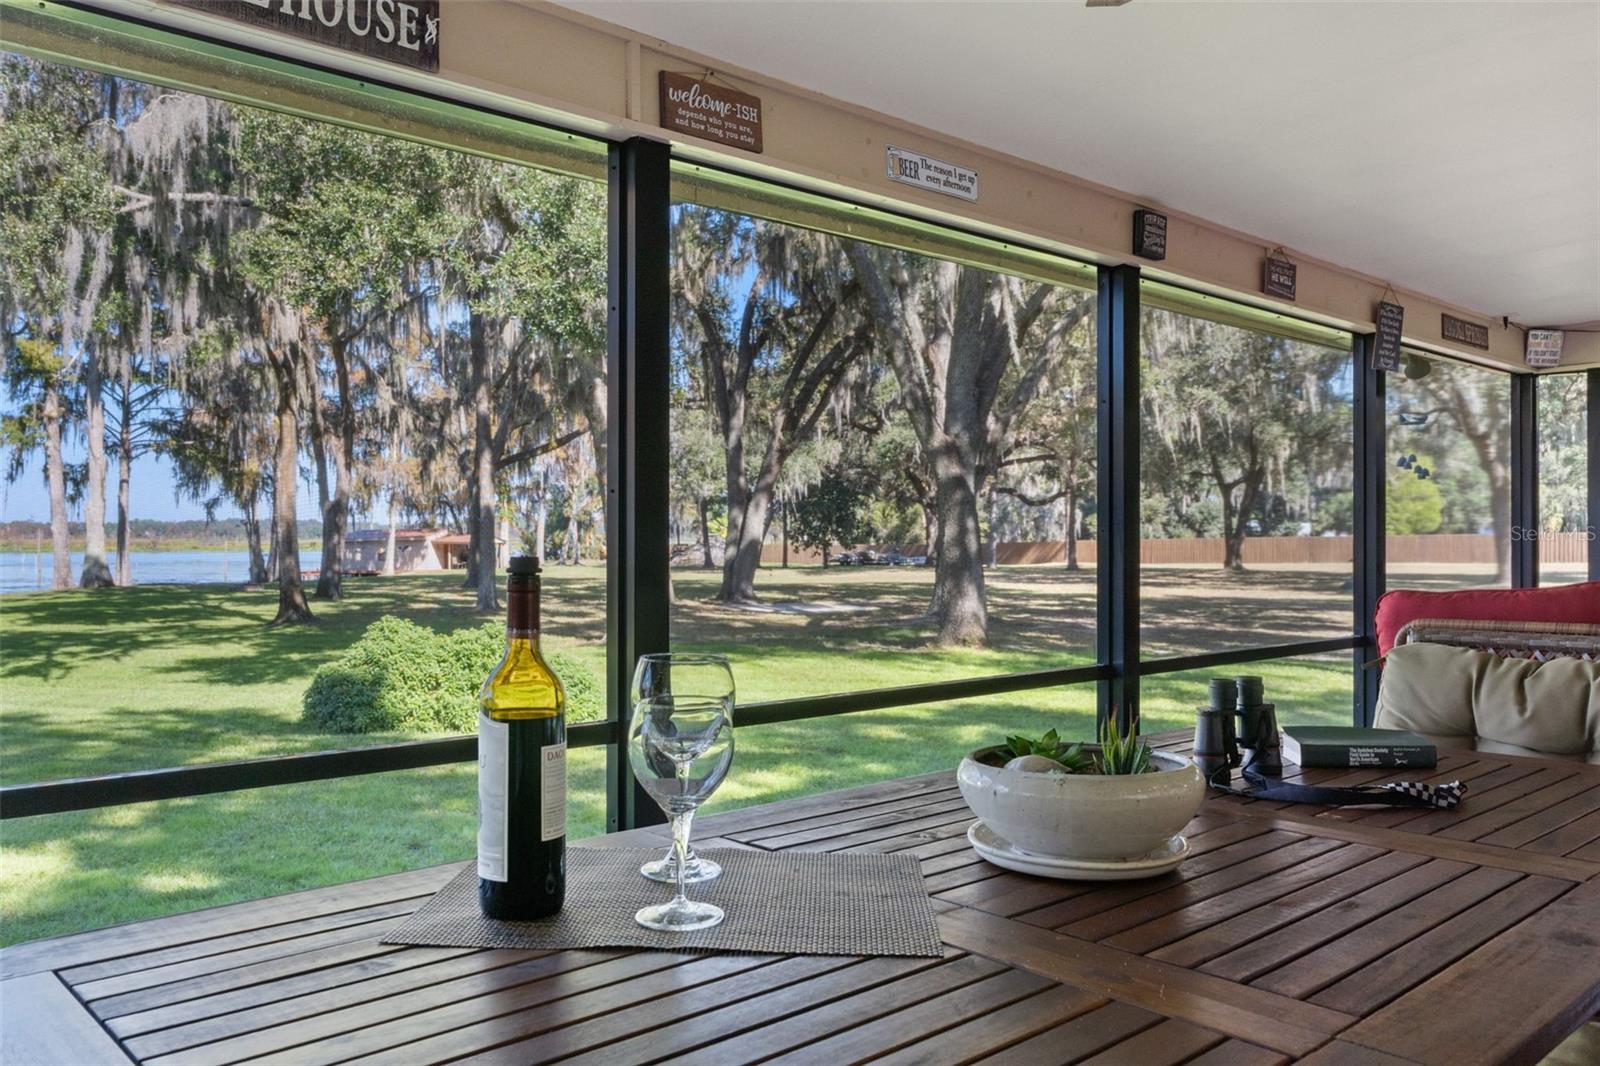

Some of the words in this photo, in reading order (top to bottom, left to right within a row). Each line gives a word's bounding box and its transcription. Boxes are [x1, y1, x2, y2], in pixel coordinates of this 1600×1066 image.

[675, 117, 689, 127] and
[691, 121, 706, 131] how
[707, 125, 723, 138] long
[725, 130, 739, 140] you
[740, 133, 755, 145] stay
[677, 107, 707, 121] depends
[709, 117, 722, 126] who
[724, 121, 738, 130] you
[740, 126, 753, 135] are,
[898, 157, 921, 181] BEER
[920, 157, 933, 171] The
[933, 166, 953, 178] reason
[953, 168, 957, 179] I
[958, 172, 967, 183] get
[967, 176, 976, 186] up
[926, 174, 942, 187] every
